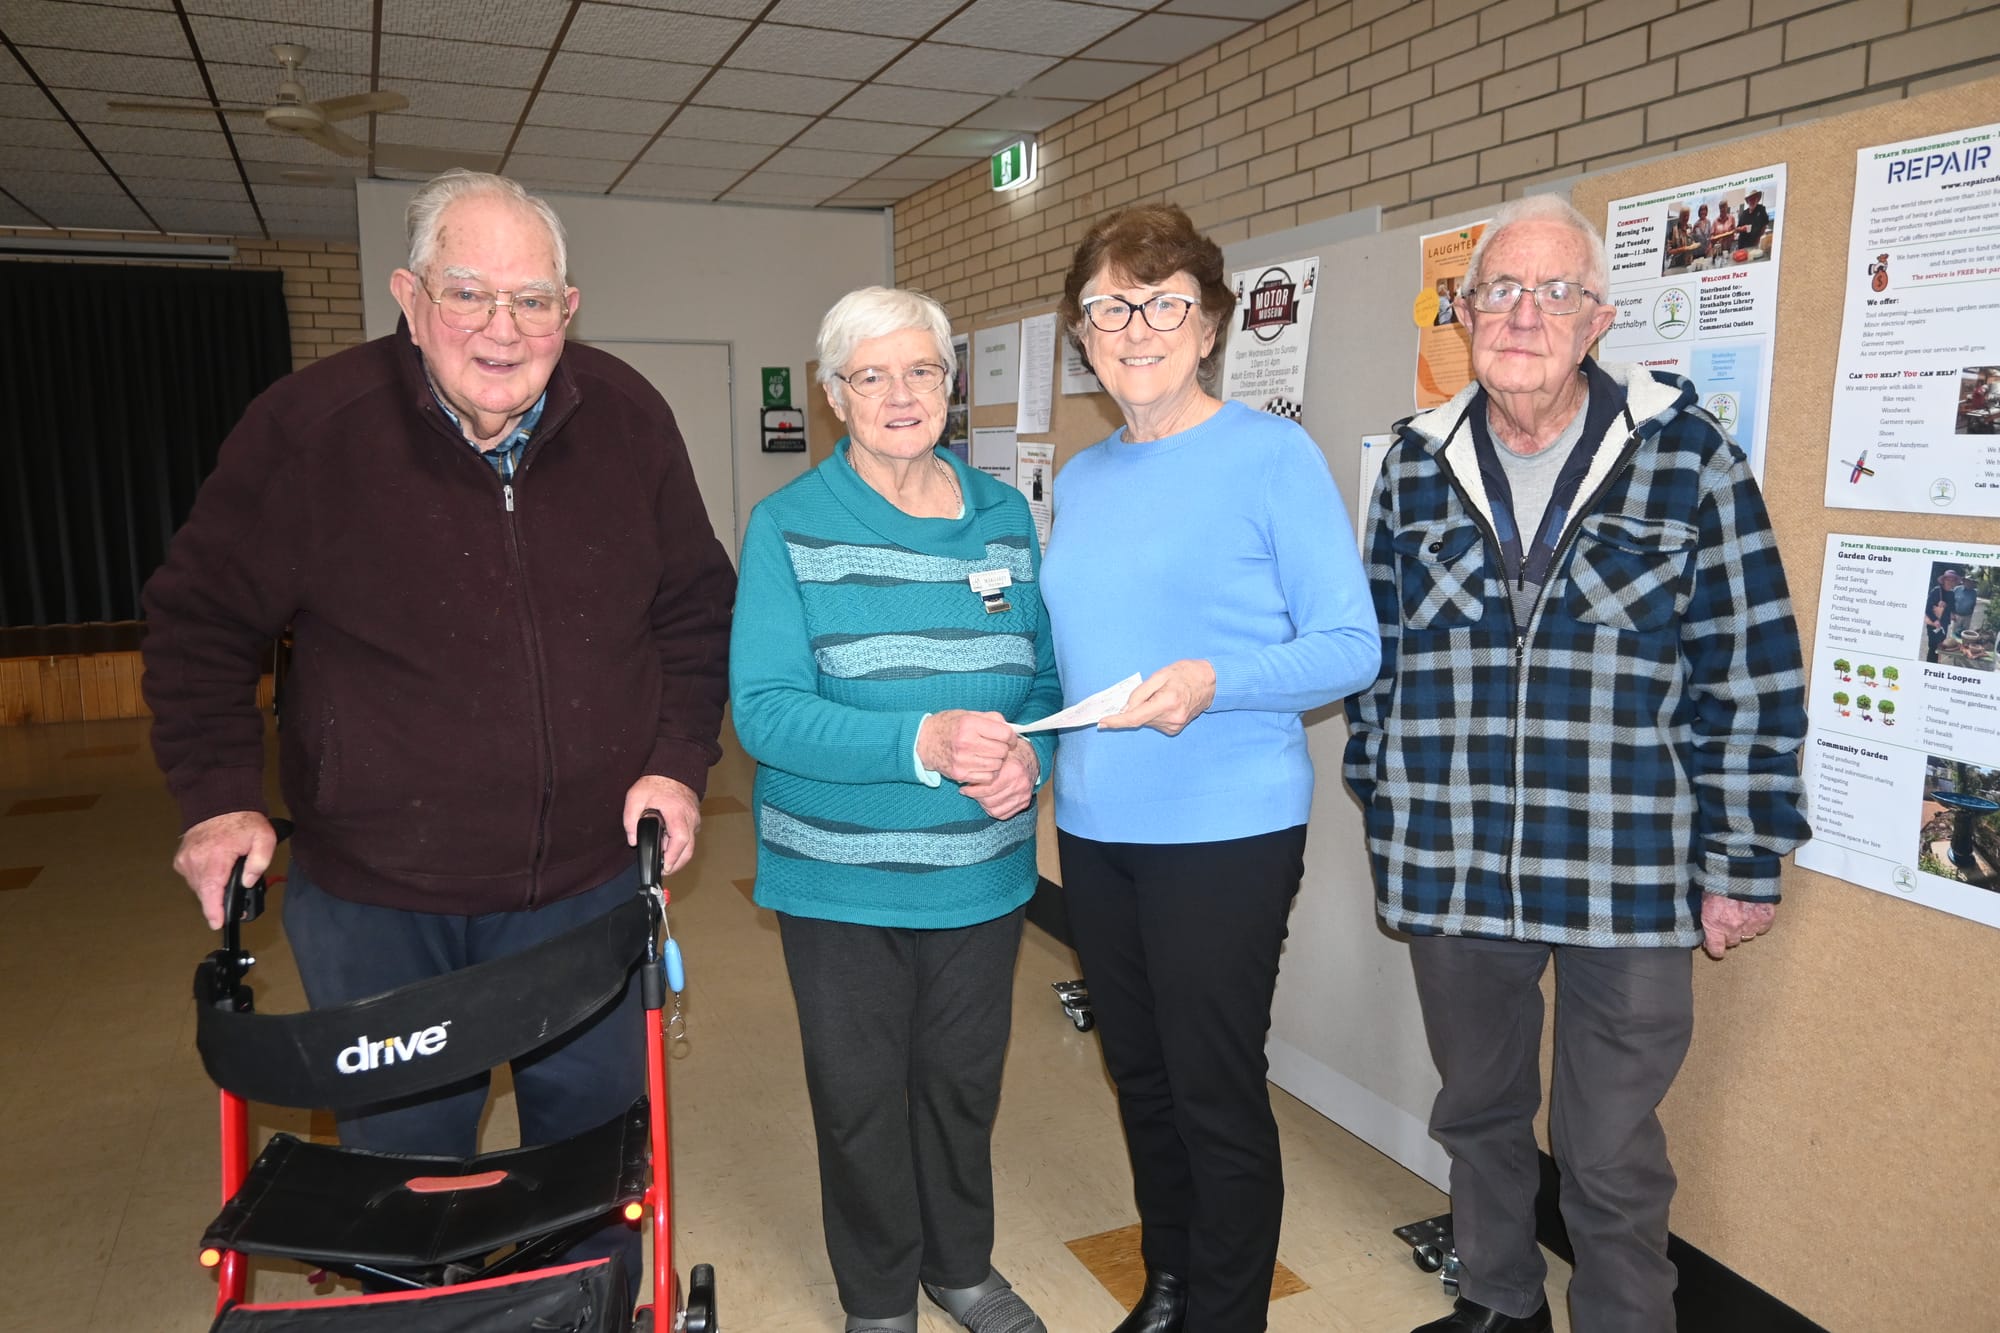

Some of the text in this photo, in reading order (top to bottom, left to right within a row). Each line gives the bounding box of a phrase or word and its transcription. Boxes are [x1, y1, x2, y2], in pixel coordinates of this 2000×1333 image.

[1888, 146, 1991, 184] REPAIR
[1617, 217, 1649, 227] COMMUNITY
[1616, 228, 1640, 237] Morning
[1627, 238, 1650, 247] Tuesday
[1428, 239, 1477, 258] LAUGHTER
[1622, 261, 1646, 269] welcome
[1702, 271, 1747, 283] WELCOME PACK
[1925, 271, 1947, 279] service
[1957, 268, 1974, 276] FREE
[1700, 286, 1730, 294] Distributed
[1256, 289, 1288, 309] MOTOR
[1714, 292, 1730, 300] Estate
[1614, 297, 1642, 307] Welcome
[1700, 300, 1732, 309] Strathalbyn
[1259, 307, 1283, 320] MUSEUM
[1720, 305, 1752, 313] Information
[1699, 322, 1732, 331] Commercial
[1875, 330, 1894, 338] repairs
[1281, 345, 1298, 353] Sunday
[1645, 358, 1678, 366] Community
[769, 376, 783, 384] AED
[1922, 548, 1948, 556] CENTRE
[1838, 552, 1892, 562] Garden Grubs
[1836, 564, 1865, 573] Gardening
[1849, 587, 1878, 595] producing
[1833, 594, 1855, 603] Crafting
[1869, 598, 1885, 606] found
[1887, 600, 1907, 609] objects
[1830, 614, 1871, 625] Garden visiting
[1829, 624, 1860, 633] Information
[1884, 631, 1904, 640] sharing
[1924, 669, 1981, 684] Fruit Loopers
[1951, 689, 1988, 698] maintenance
[1928, 705, 1949, 715] Pruning
[1926, 716, 1947, 725] Disease
[1817, 739, 1888, 760] Community Garden
[1923, 739, 1953, 751] Harvesting
[1836, 757, 1860, 767] producing
[1875, 777, 1893, 786] sharing
[1817, 805, 1831, 813] Social
